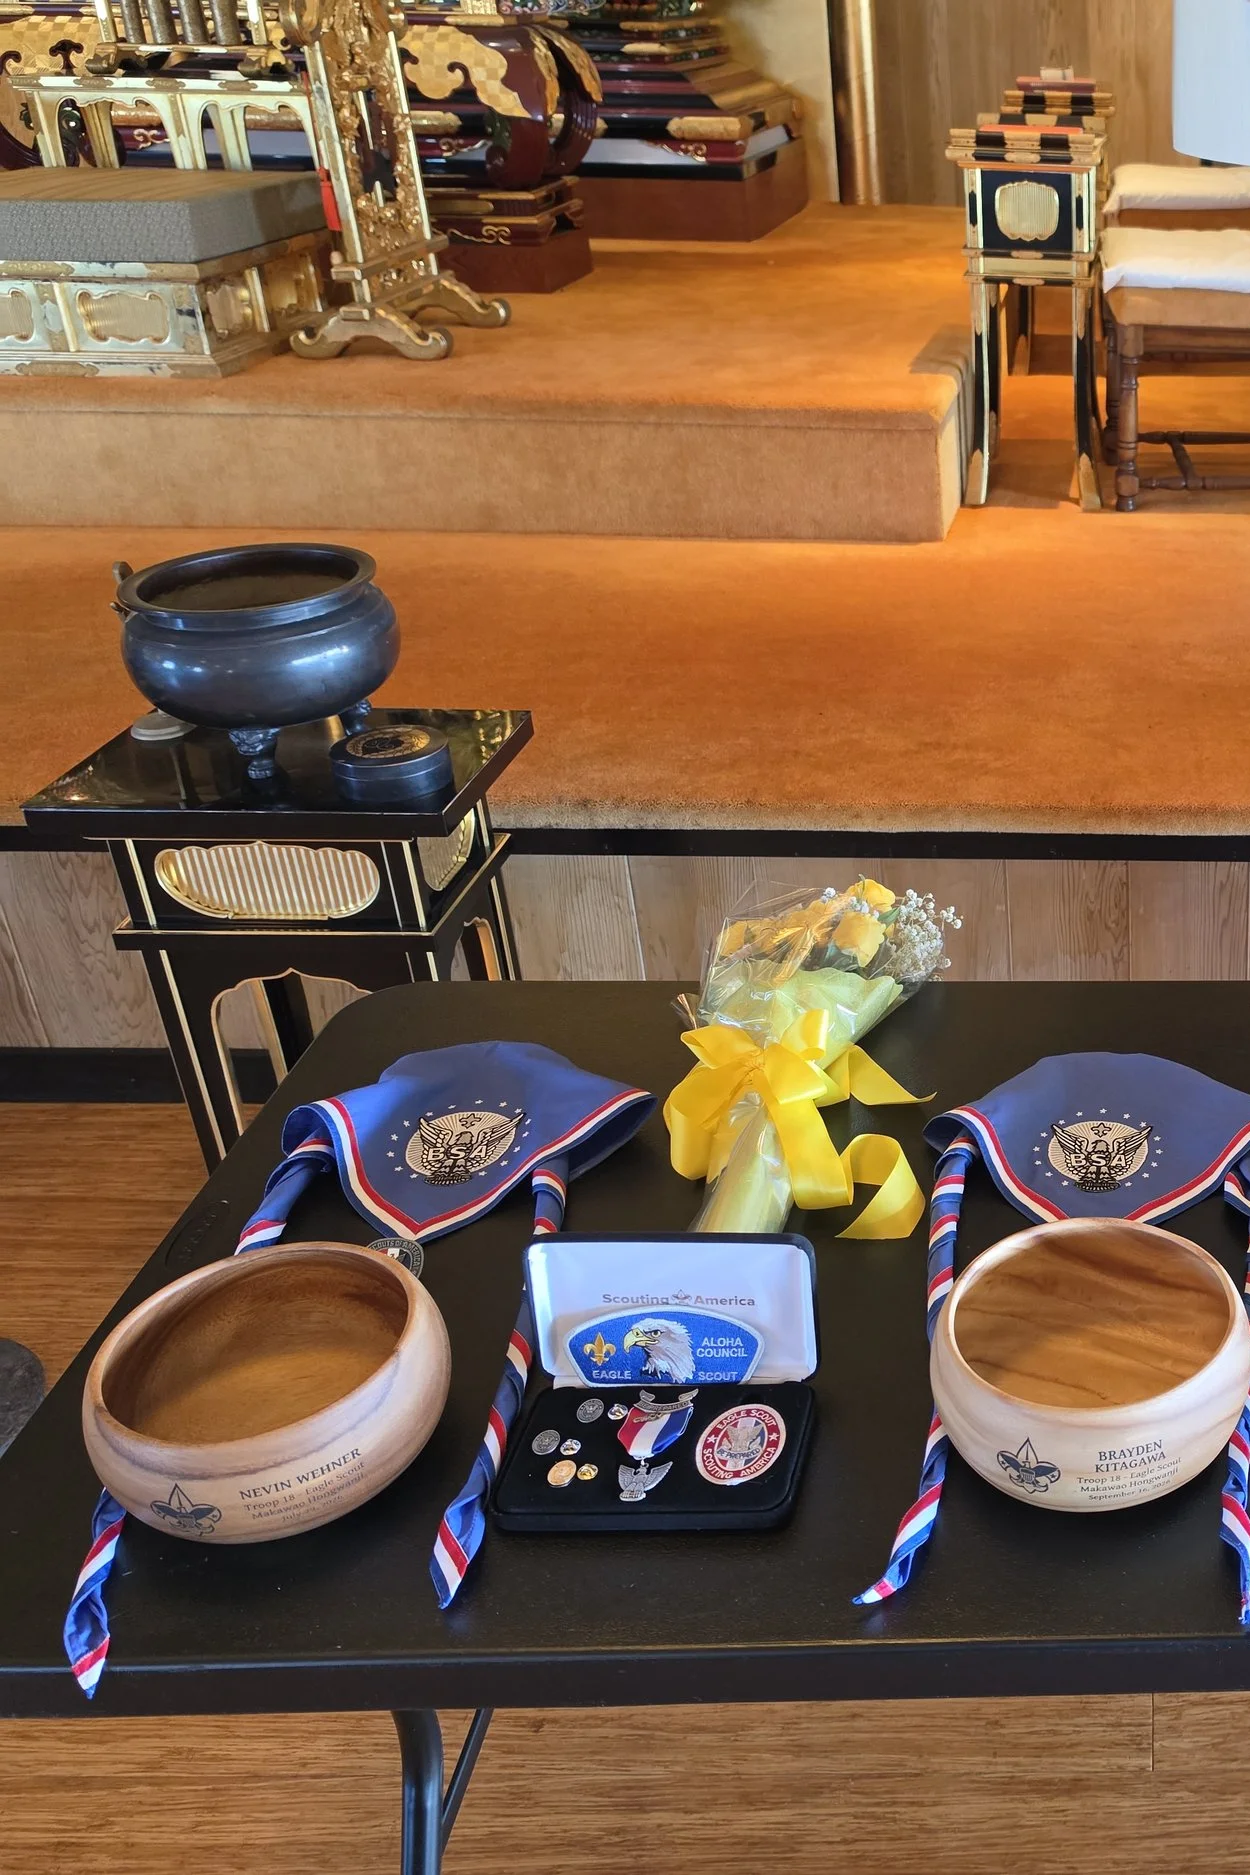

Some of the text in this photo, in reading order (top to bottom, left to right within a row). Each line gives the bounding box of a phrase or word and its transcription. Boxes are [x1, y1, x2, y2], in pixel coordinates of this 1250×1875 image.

[428, 1145, 487, 1161] BSA
[1070, 1153, 1127, 1166] BSA
[602, 1294, 755, 1306] Scouting America
[702, 1337, 743, 1347] ALOHA
[697, 1348, 748, 1357] COUNCIL
[592, 1370, 738, 1381] EAGLE SCOUT
[717, 1409, 776, 1430] EAGLE SCOUT
[726, 1447, 760, 1459] PREPARED
[1098, 1439, 1163, 1461] BRAYDEN
[703, 1447, 776, 1479] SCOUTING AMERICA
[1077, 1477, 1107, 1485] Troop
[1130, 1467, 1155, 1480] Eagle
[1157, 1457, 1181, 1471] Scout
[1095, 1451, 1166, 1473] KITAGAWA
[239, 1448, 361, 1500] NEVIN WEHNER
[1080, 1467, 1179, 1492] Makawao Hongwanji
[244, 1498, 279, 1512] Troop
[284, 1494, 295, 1502] 18
[305, 1479, 334, 1495] Eagle
[336, 1462, 365, 1480] Scout
[1088, 1490, 1135, 1501] September
[252, 1501, 305, 1520] Makawao
